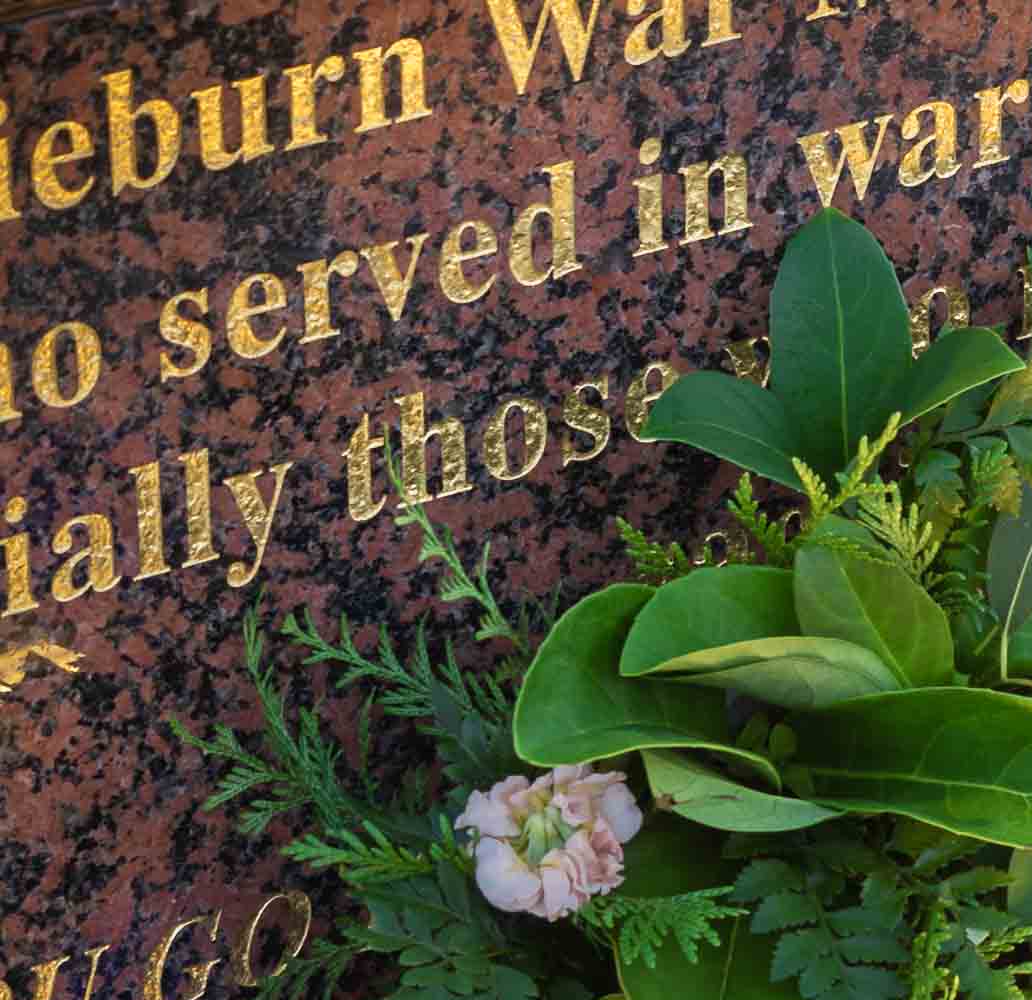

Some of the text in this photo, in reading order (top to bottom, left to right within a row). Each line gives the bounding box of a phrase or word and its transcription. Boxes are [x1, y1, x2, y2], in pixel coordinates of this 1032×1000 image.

[159, 160, 584, 382] served
[632, 140, 754, 258] in
[346, 365, 680, 522] those
